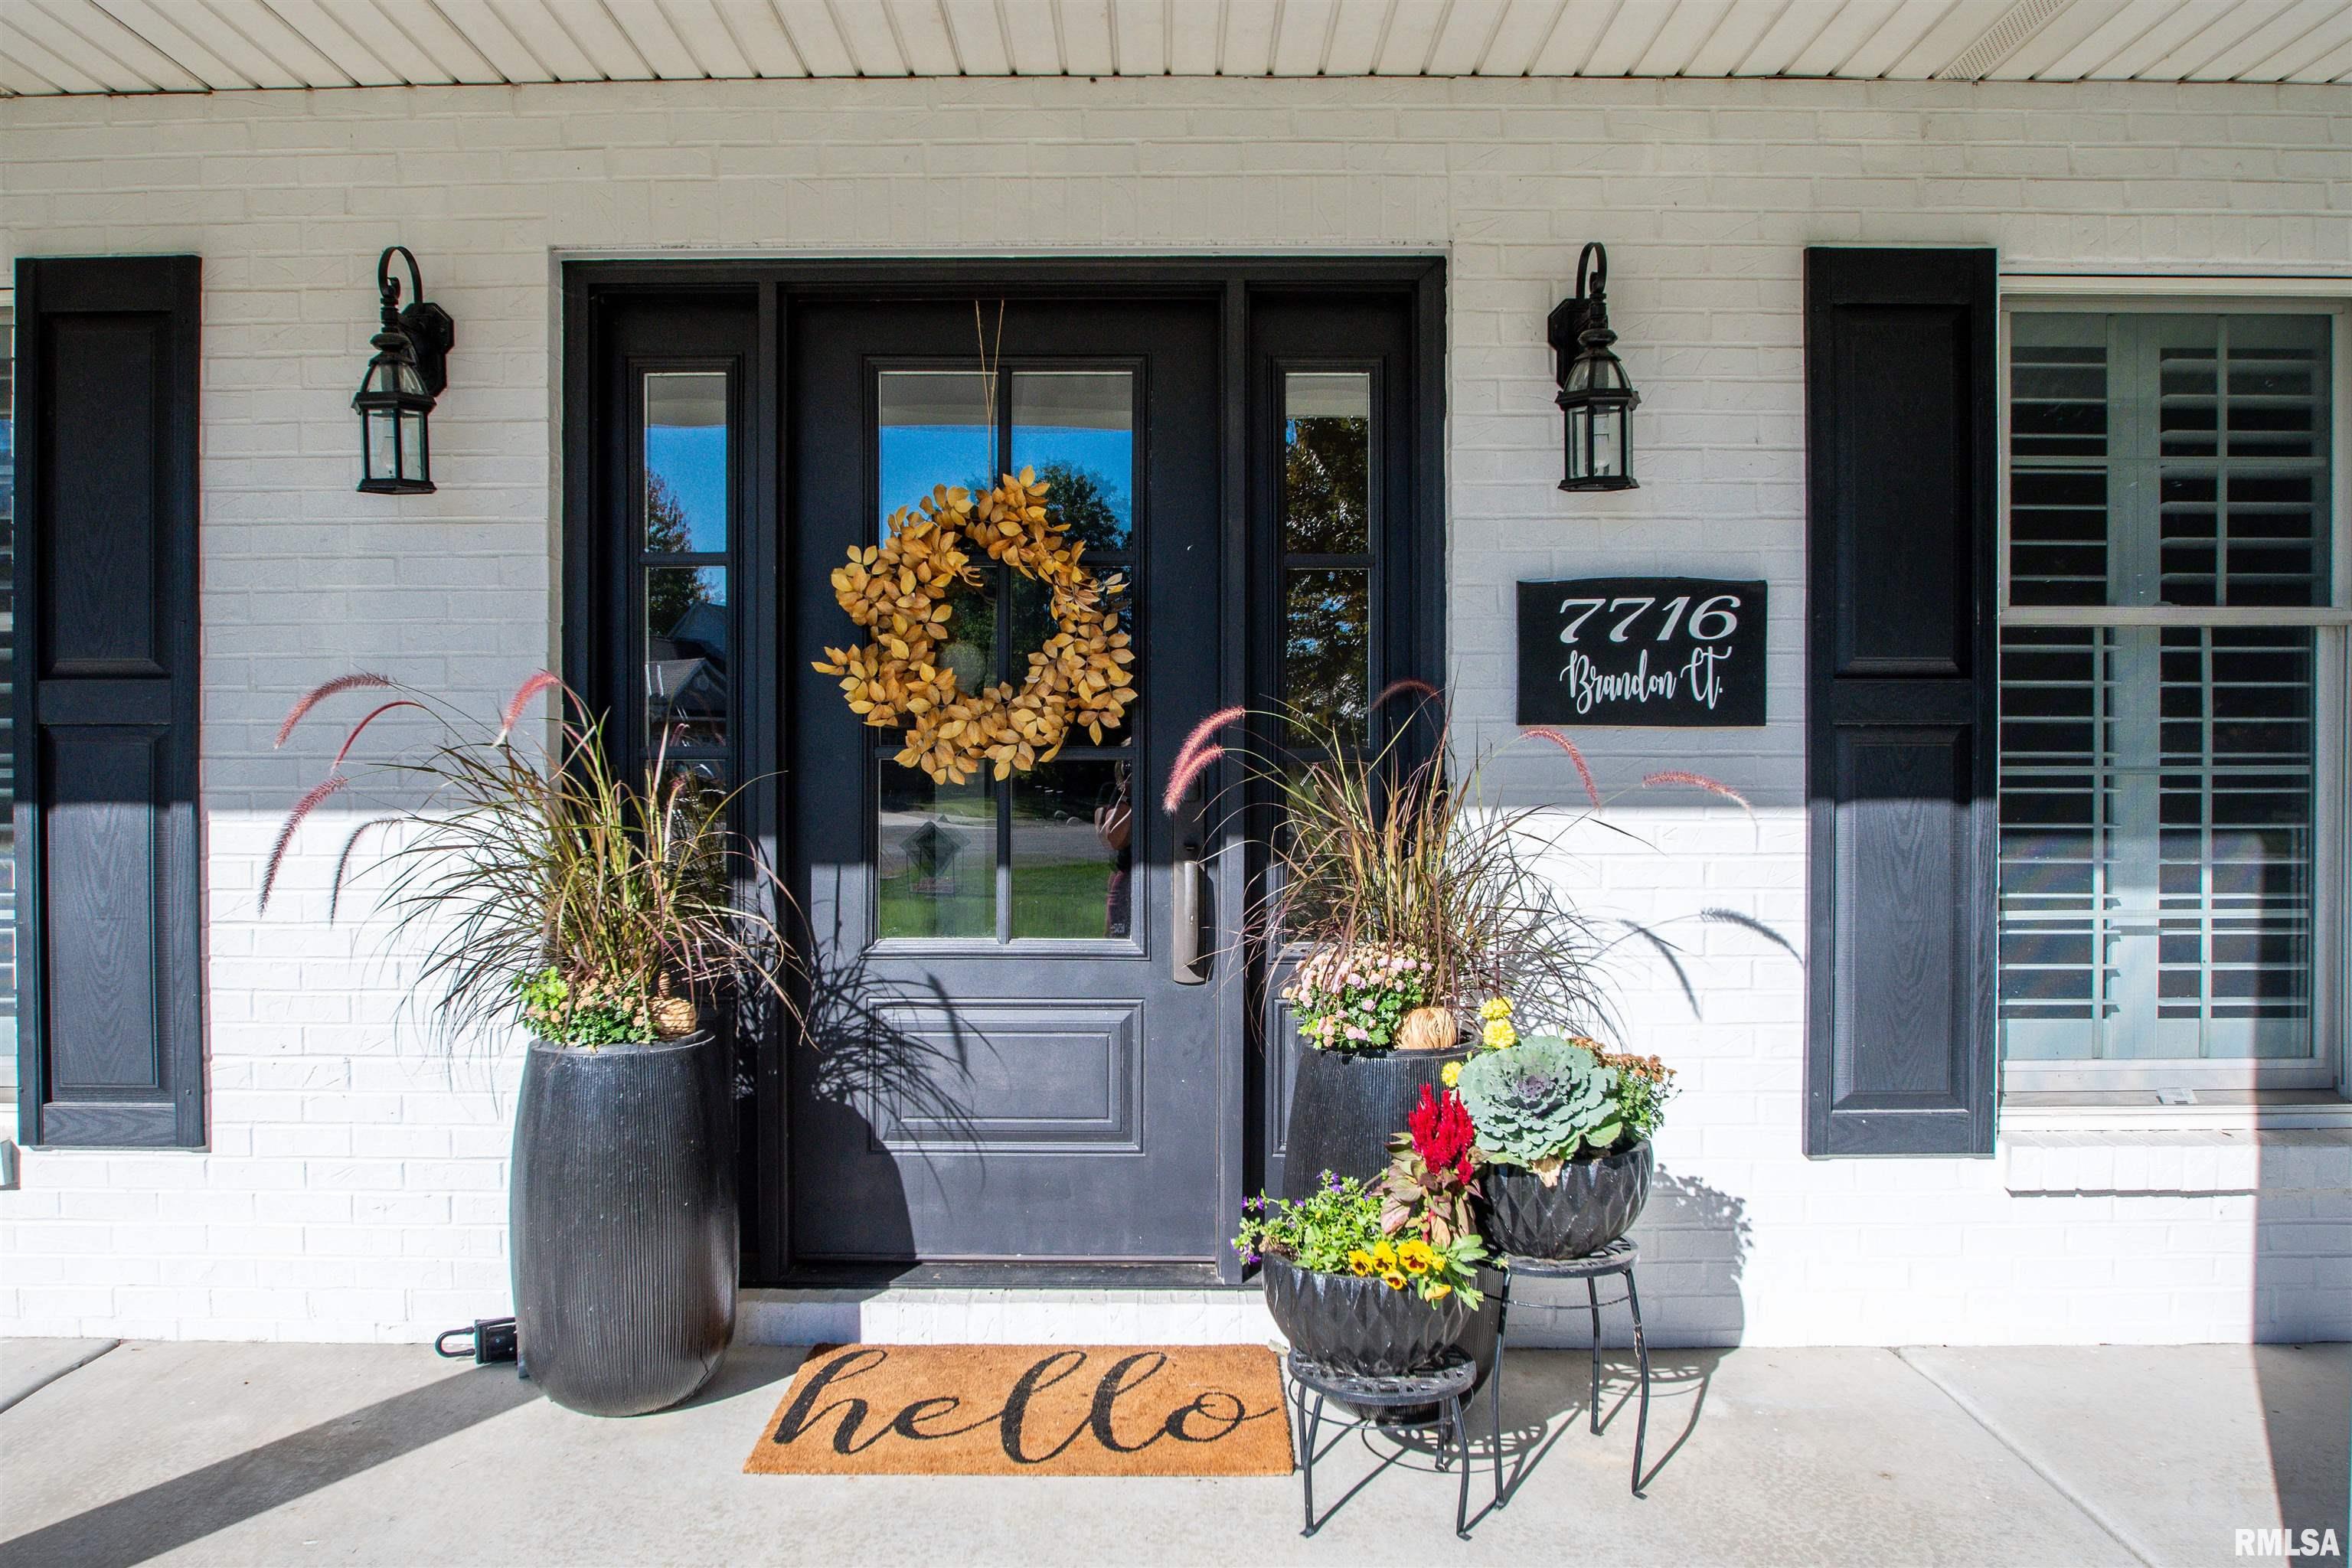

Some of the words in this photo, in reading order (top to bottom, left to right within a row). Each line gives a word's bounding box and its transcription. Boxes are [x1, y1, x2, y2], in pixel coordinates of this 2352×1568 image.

[1560, 595, 1741, 644] 7716
[1559, 649, 1677, 714] Brandon
[1681, 646, 1733, 710] Ct.
[773, 1350, 1279, 1463] hello
